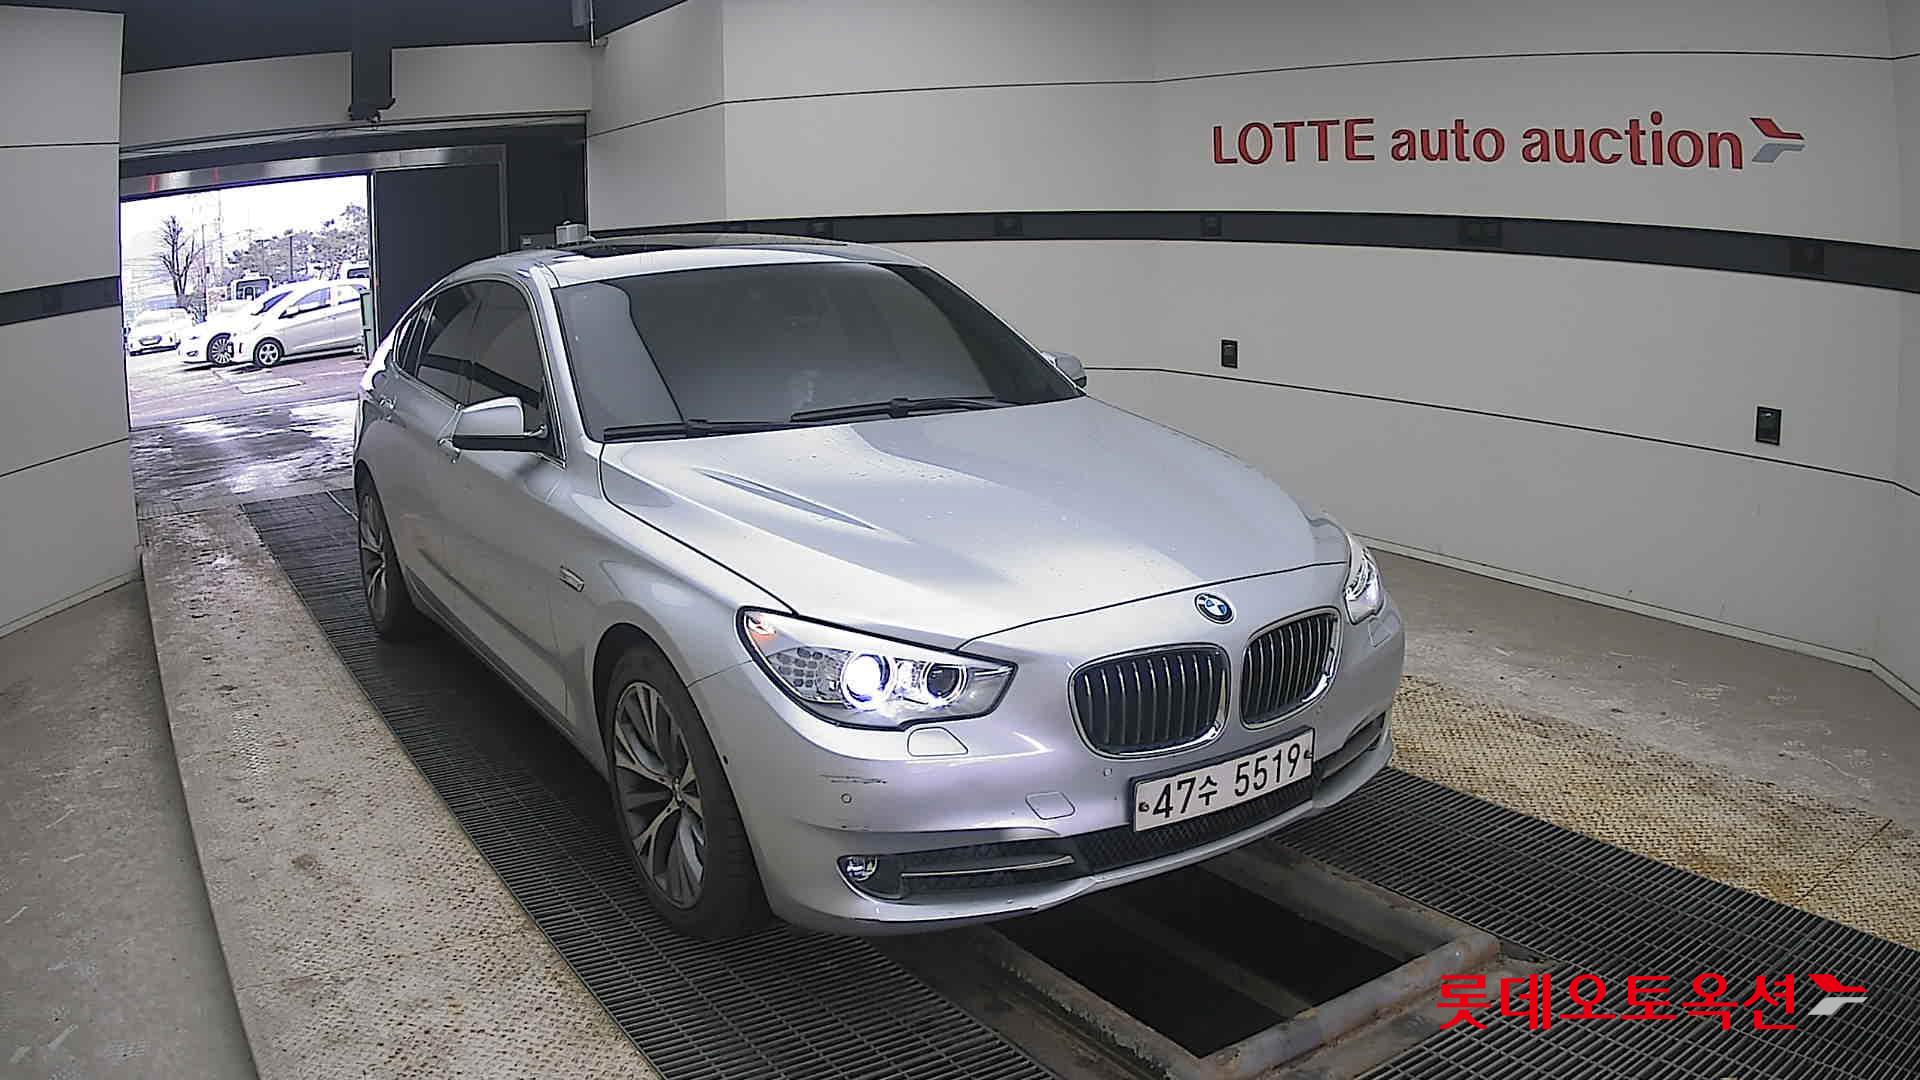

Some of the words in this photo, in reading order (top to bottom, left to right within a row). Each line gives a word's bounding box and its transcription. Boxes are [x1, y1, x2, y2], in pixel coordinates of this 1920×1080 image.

[1212, 117, 1375, 165] LOTTE
[1390, 119, 1506, 164] auto
[1521, 111, 1744, 170] auction
[1151, 775, 1218, 819] 47수
[1234, 743, 1301, 797] 5519
